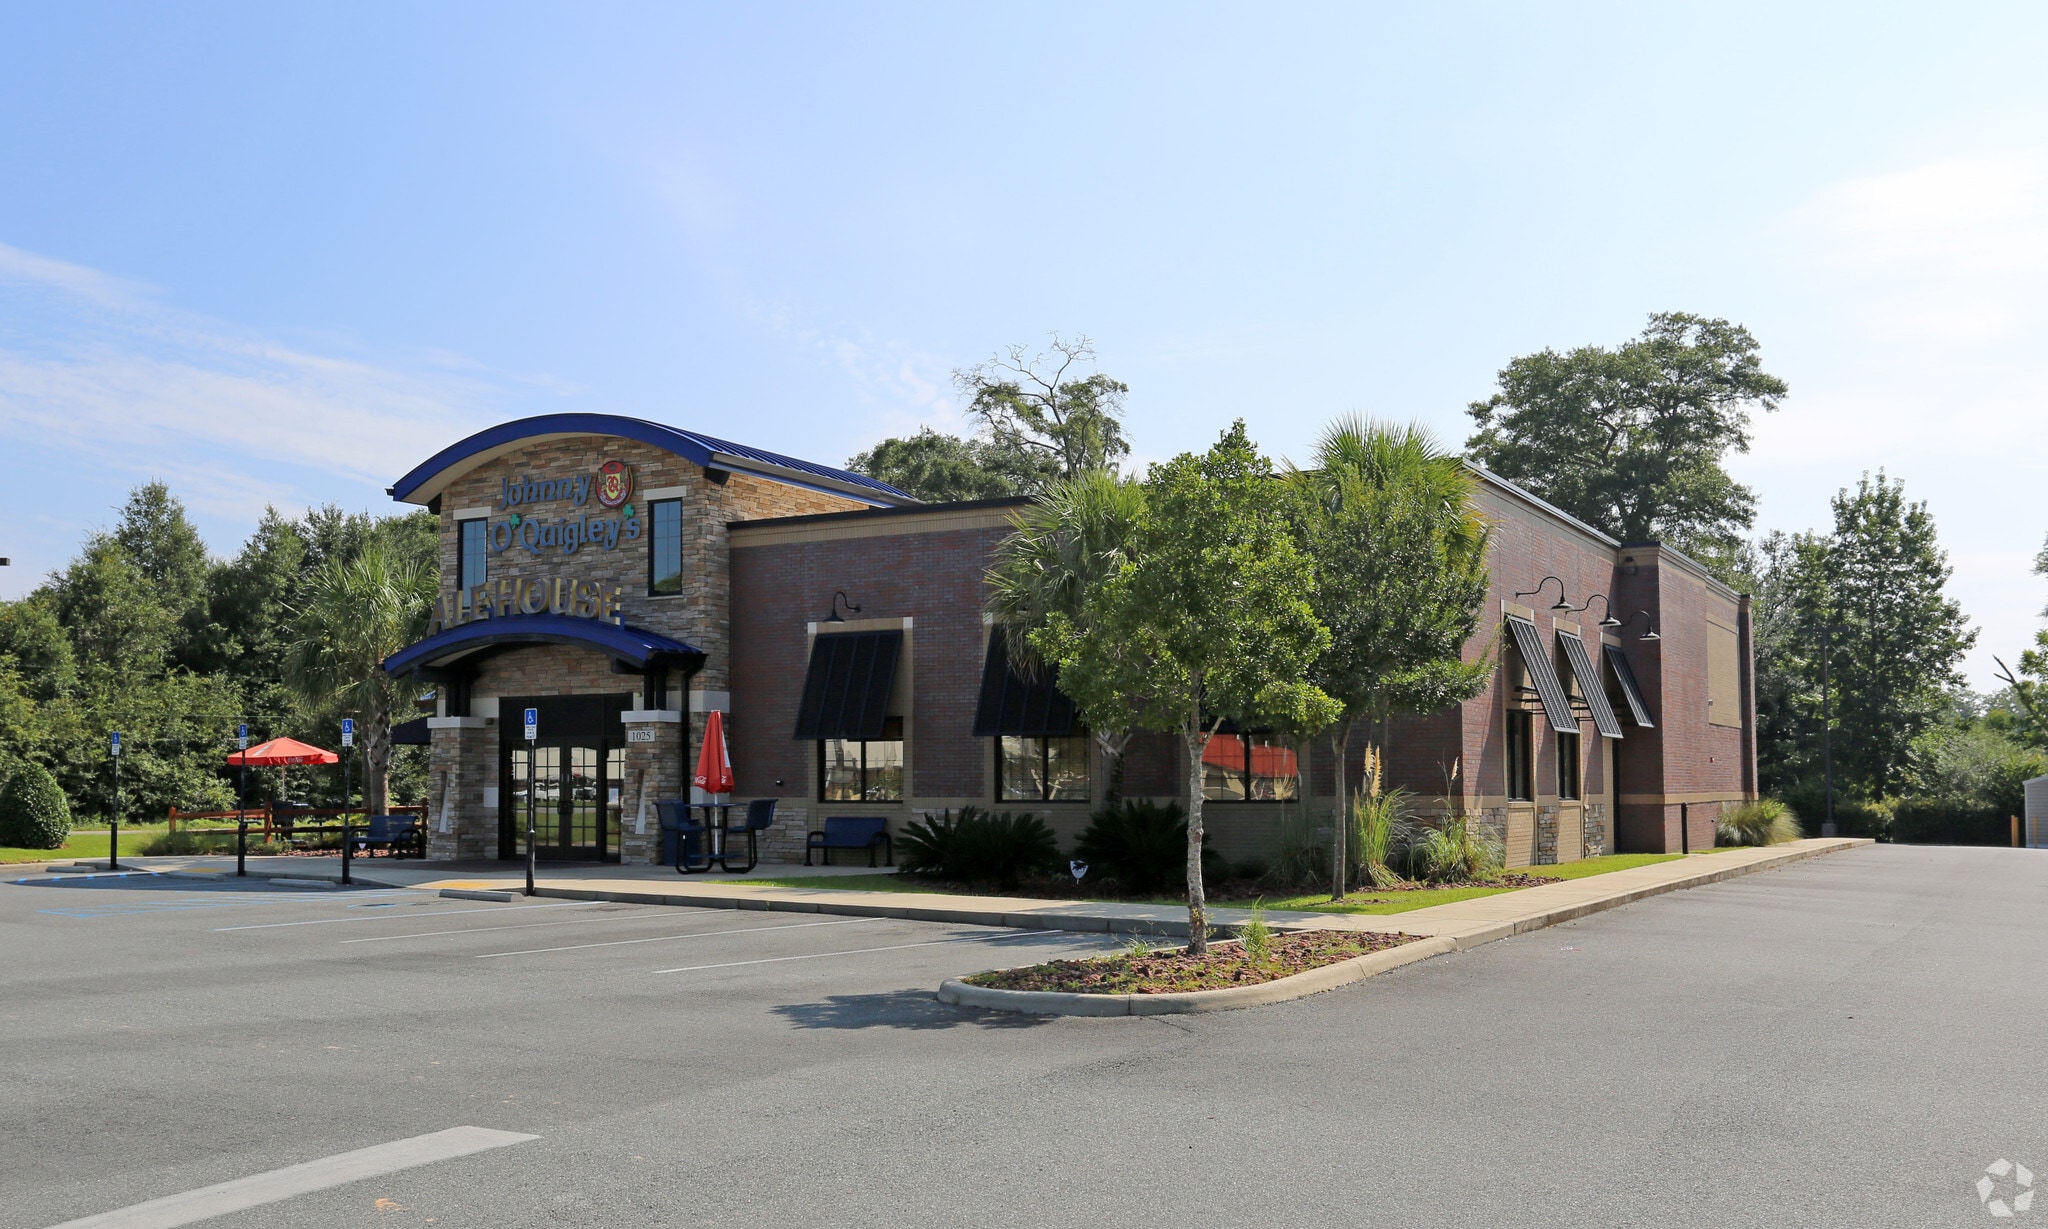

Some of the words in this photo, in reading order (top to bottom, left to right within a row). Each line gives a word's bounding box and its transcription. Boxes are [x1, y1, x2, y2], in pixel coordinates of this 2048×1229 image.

[498, 474, 591, 511] Johnny
[426, 577, 621, 637] ALEHOUSE
[632, 731, 650, 741] 1025
